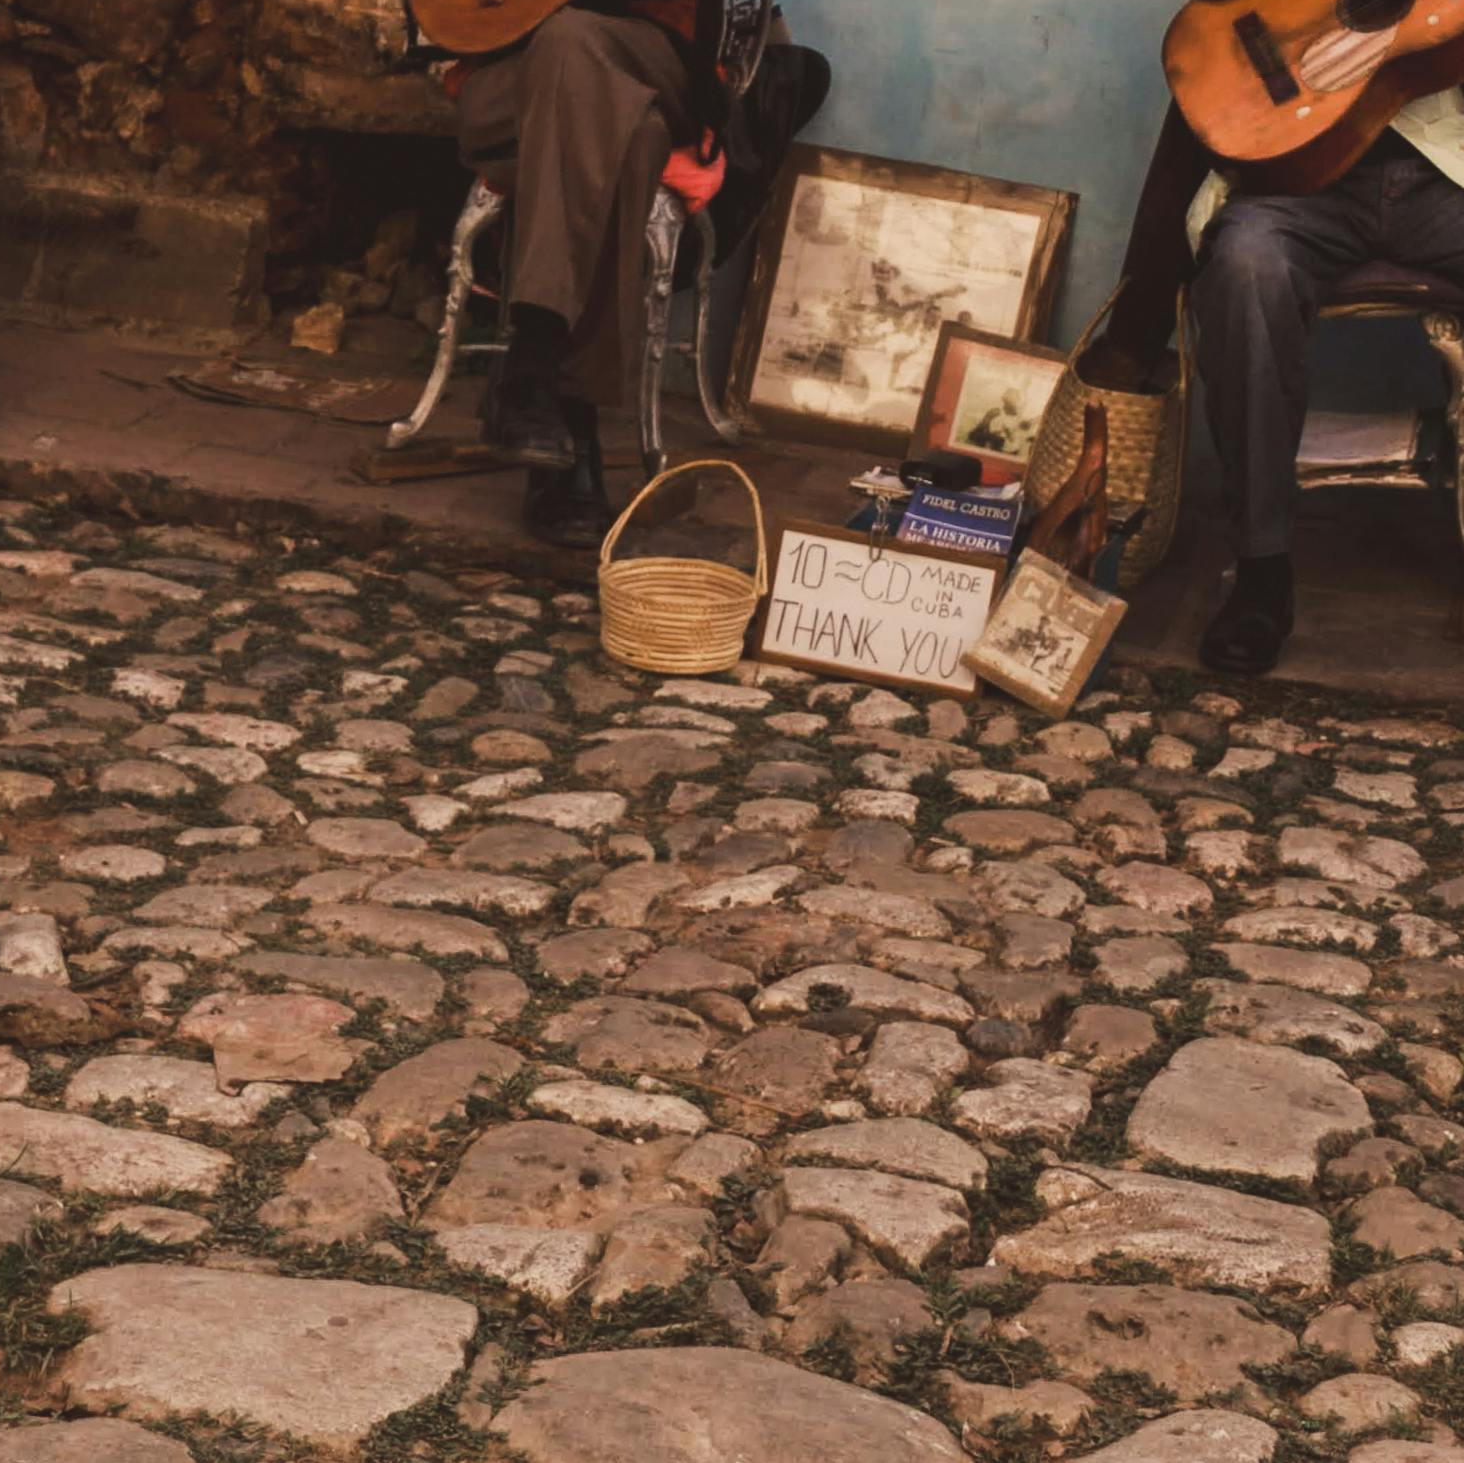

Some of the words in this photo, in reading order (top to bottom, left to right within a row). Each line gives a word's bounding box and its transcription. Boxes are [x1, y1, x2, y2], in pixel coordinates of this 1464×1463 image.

[922, 493, 957, 513] FIDEL
[960, 502, 1011, 521] CASTRO
[908, 520, 930, 536] LA
[932, 524, 1001, 552] HISTORIA
[788, 539, 828, 590] 10
[861, 558, 912, 604] CD
[921, 565, 981, 593] MADE
[911, 597, 963, 619] CUBA
[936, 591, 954, 603] IN
[774, 598, 883, 664] THANK
[899, 627, 963, 679] YOU
